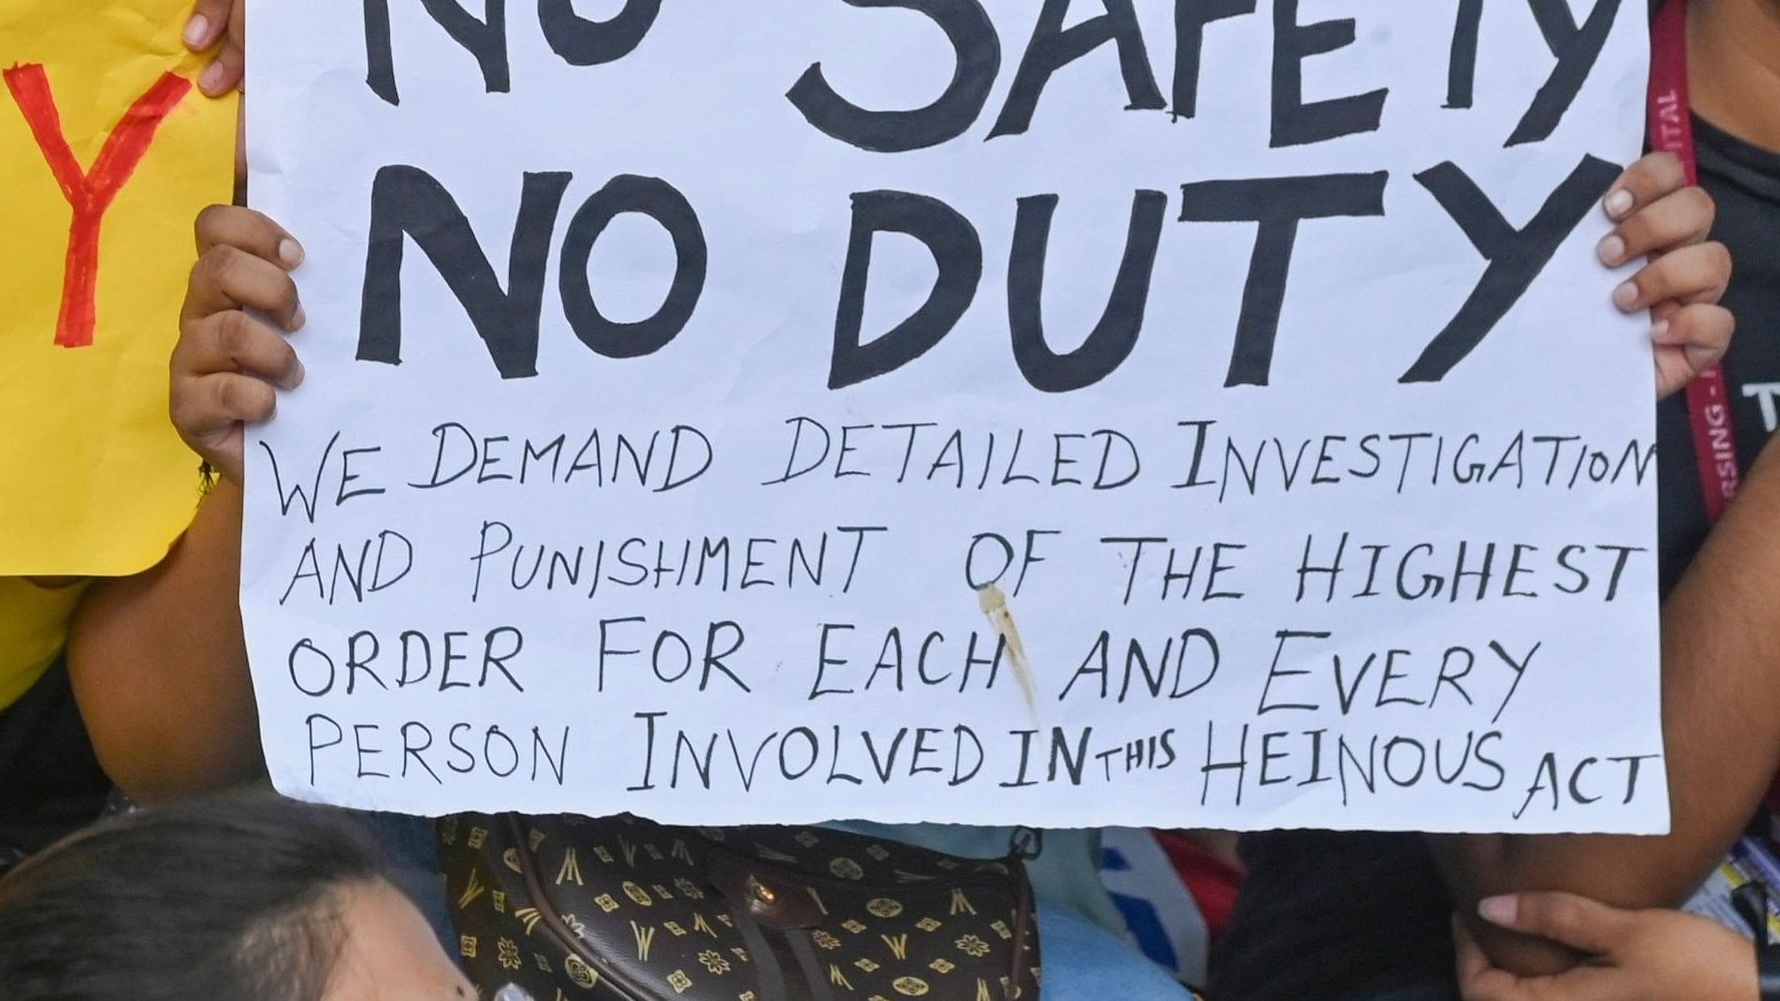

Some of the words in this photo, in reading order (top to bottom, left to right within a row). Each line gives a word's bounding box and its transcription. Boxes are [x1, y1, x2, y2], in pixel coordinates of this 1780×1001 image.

[355, 164, 709, 380] NO
[826, 153, 1623, 393] DUTY
[258, 428, 388, 524] WE
[406, 421, 714, 493] DEMAND
[760, 415, 1141, 490] DETAILED
[1169, 420, 1659, 504] INVESTIGATION
[278, 536, 414, 607] AND
[469, 519, 890, 604] PUNISHMENT
[963, 529, 1063, 599] OF
[1098, 536, 1247, 606] THE
[1294, 530, 1648, 604] HIGHEST
[287, 625, 525, 698] ORDER
[595, 615, 751, 694] FOR
[807, 622, 1009, 702] EACH
[1057, 629, 1221, 705] AND
[1256, 628, 1542, 725] EVERY
[304, 712, 571, 788] PERSON
[625, 710, 986, 792] INVOLVED
[997, 725, 1093, 789] IN
[1094, 727, 1177, 783] THIS
[1199, 719, 1507, 807] HEINOUS
[1512, 752, 1662, 821] ACT
